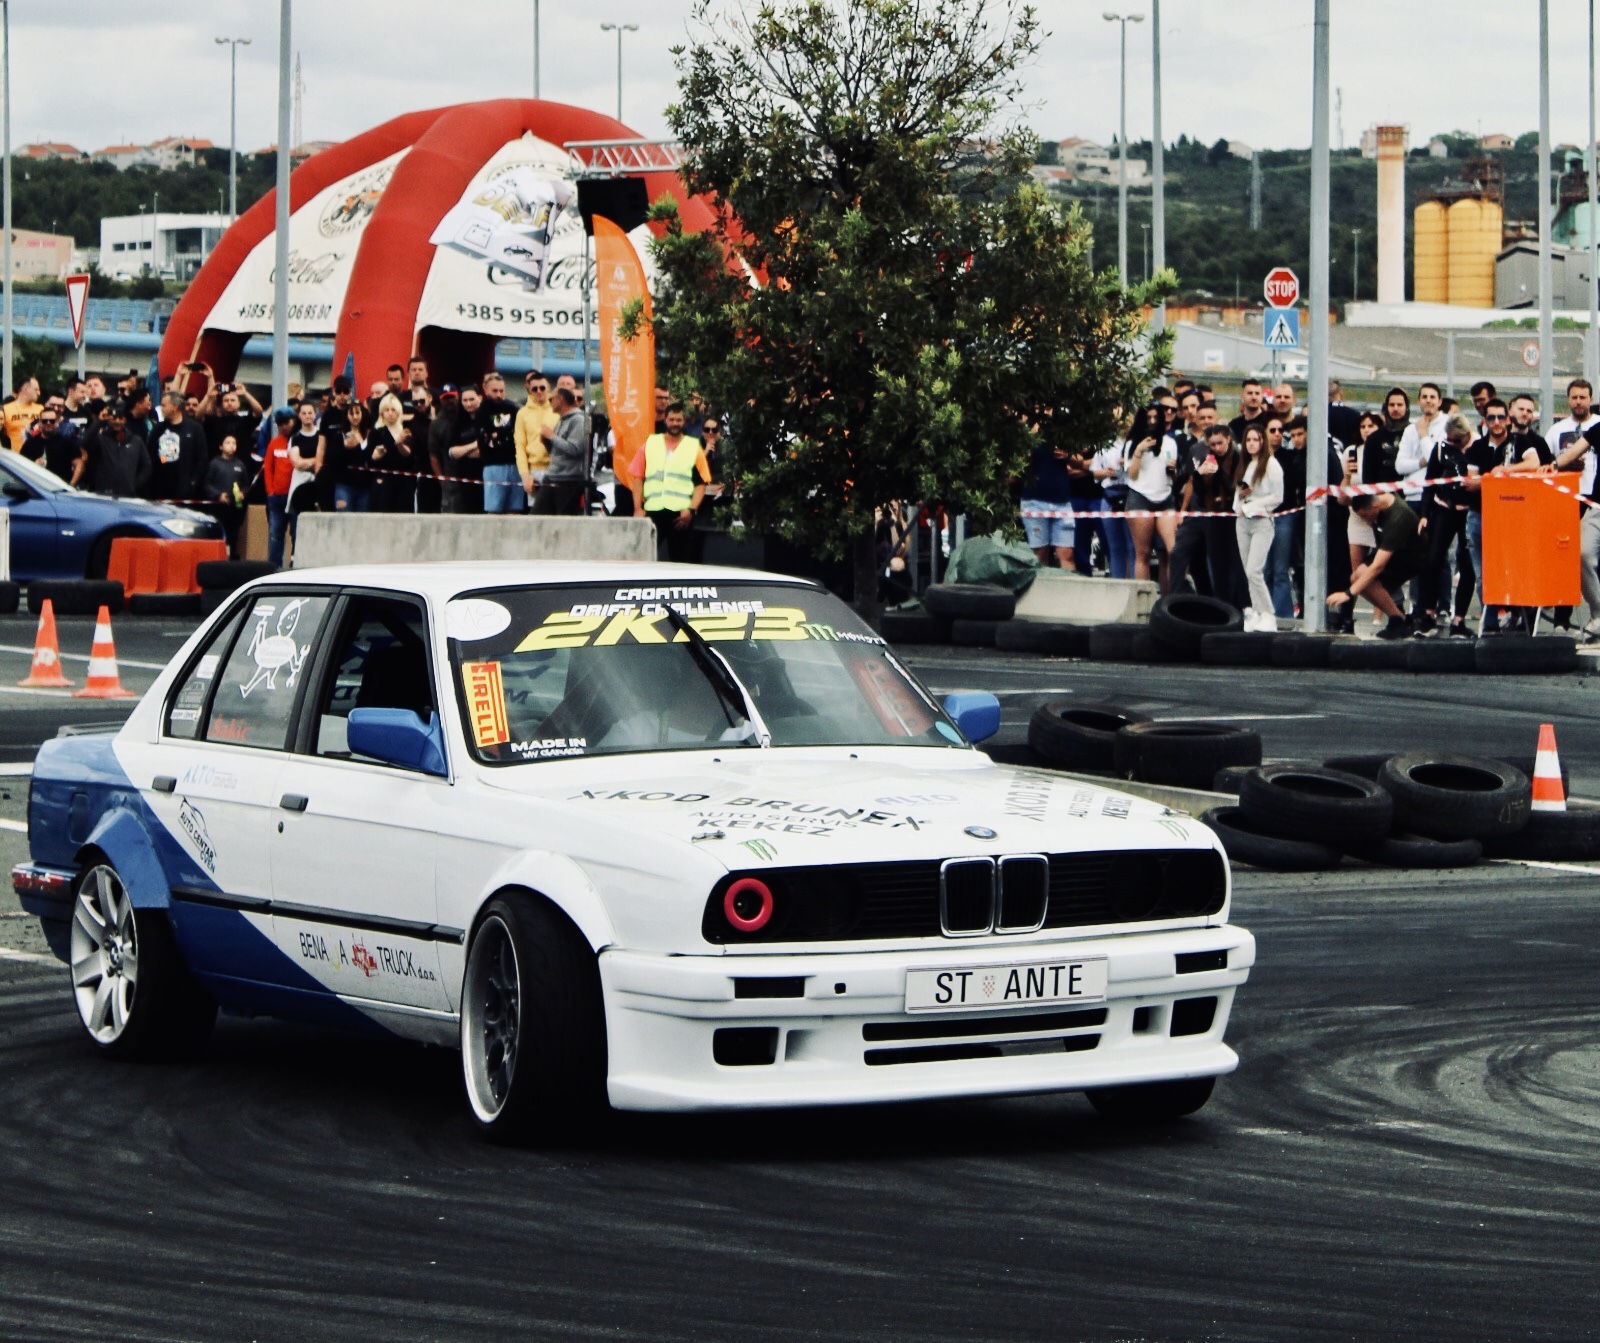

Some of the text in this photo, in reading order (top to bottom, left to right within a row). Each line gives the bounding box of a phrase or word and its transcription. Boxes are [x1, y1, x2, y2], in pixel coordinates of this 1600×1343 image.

[1267, 280, 1295, 297] STOP
[456, 302, 504, 322] +385
[510, 308, 535, 324] 95
[543, 309, 584, 325] 506
[614, 586, 718, 601] CROATIAN
[569, 600, 766, 617] DRIFT CHALLENGE
[513, 607, 809, 653] 2K23
[470, 662, 507, 745] PIRELLI
[511, 737, 587, 753] MADE IN
[183, 764, 216, 785] ALTO
[567, 789, 933, 831] XKOD BRUNEX
[767, 814, 858, 828] SERVIS
[180, 811, 214, 861] AUTO CENTAR
[697, 819, 834, 837] KEKEZ
[376, 946, 417, 977] TRUCK
[418, 967, 438, 982] d.o.o.
[935, 964, 1083, 1003] ST ANTE
